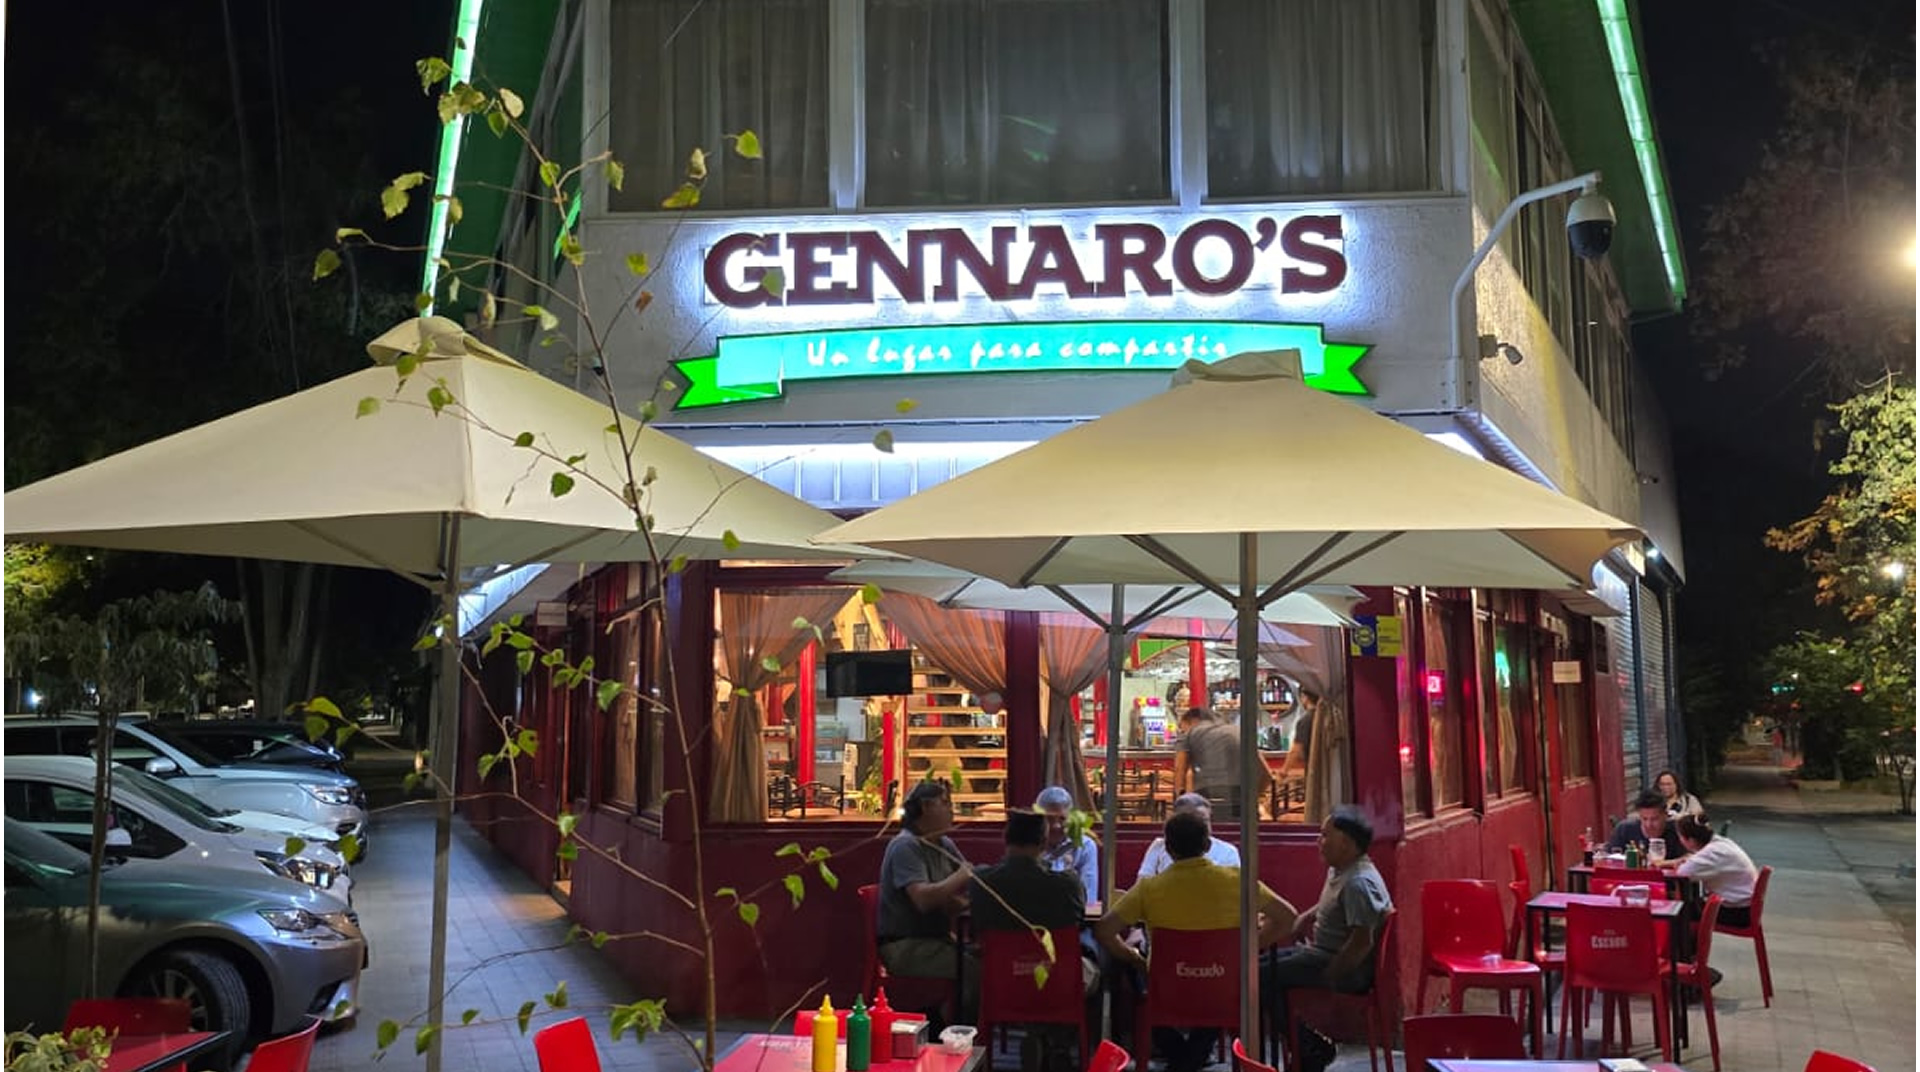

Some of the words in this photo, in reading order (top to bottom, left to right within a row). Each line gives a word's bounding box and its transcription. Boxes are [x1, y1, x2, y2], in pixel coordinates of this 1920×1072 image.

[703, 215, 1349, 309] GENNARO'S
[807, 338, 850, 367] Un
[866, 336, 953, 372] lugar
[970, 340, 1042, 370] para
[1059, 334, 1227, 366] compartir
[1176, 962, 1226, 978] Escudo
